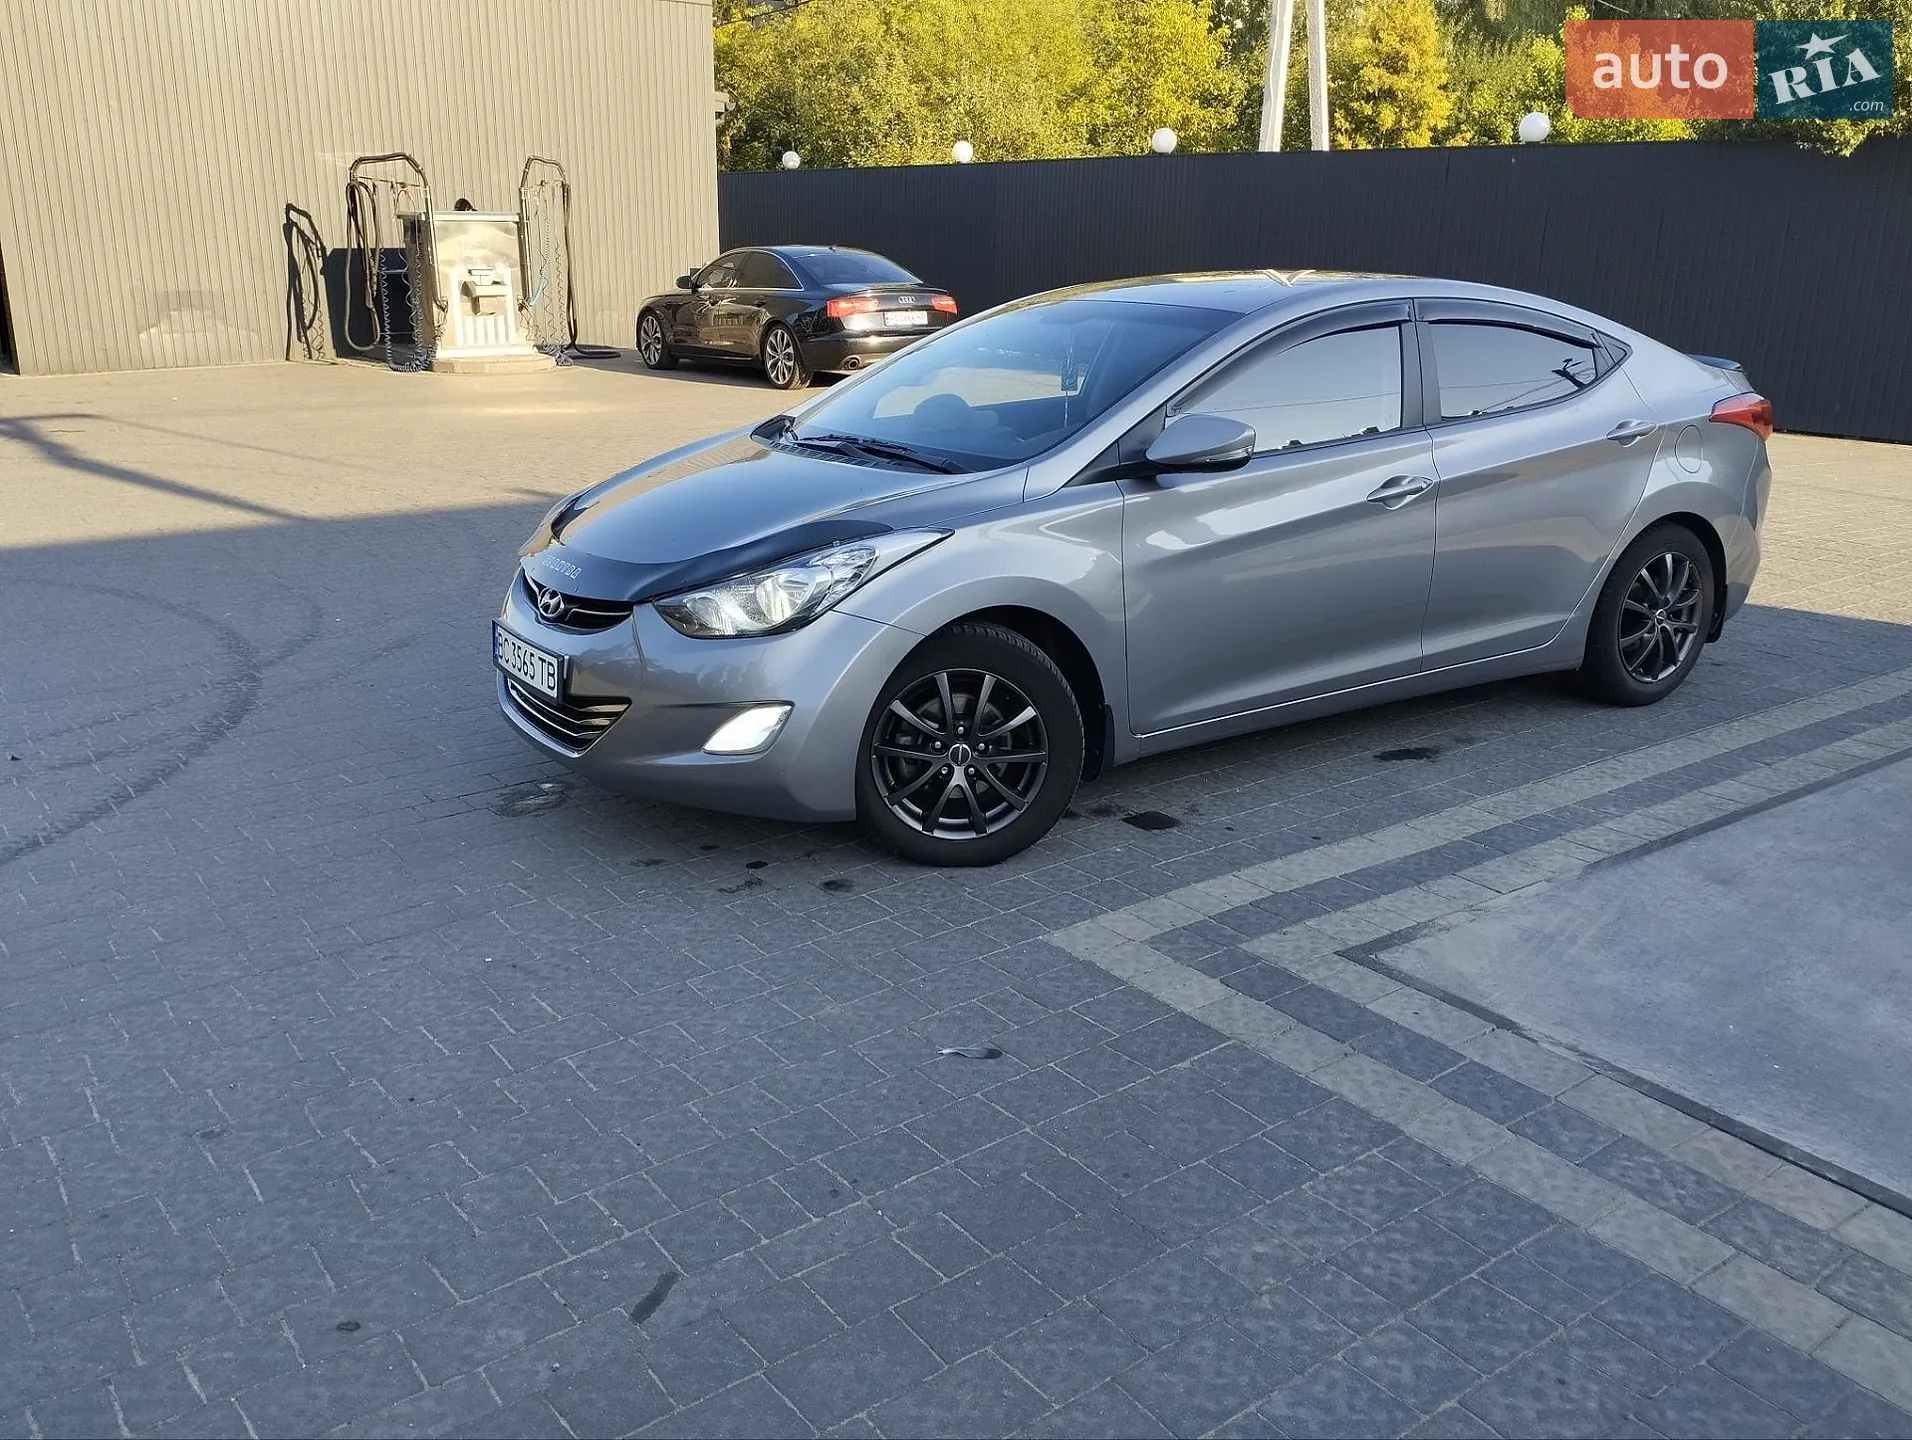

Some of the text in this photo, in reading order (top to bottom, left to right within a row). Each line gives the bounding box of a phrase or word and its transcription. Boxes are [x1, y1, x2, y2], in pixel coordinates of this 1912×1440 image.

[498, 632, 556, 691] BC 3565 TB
